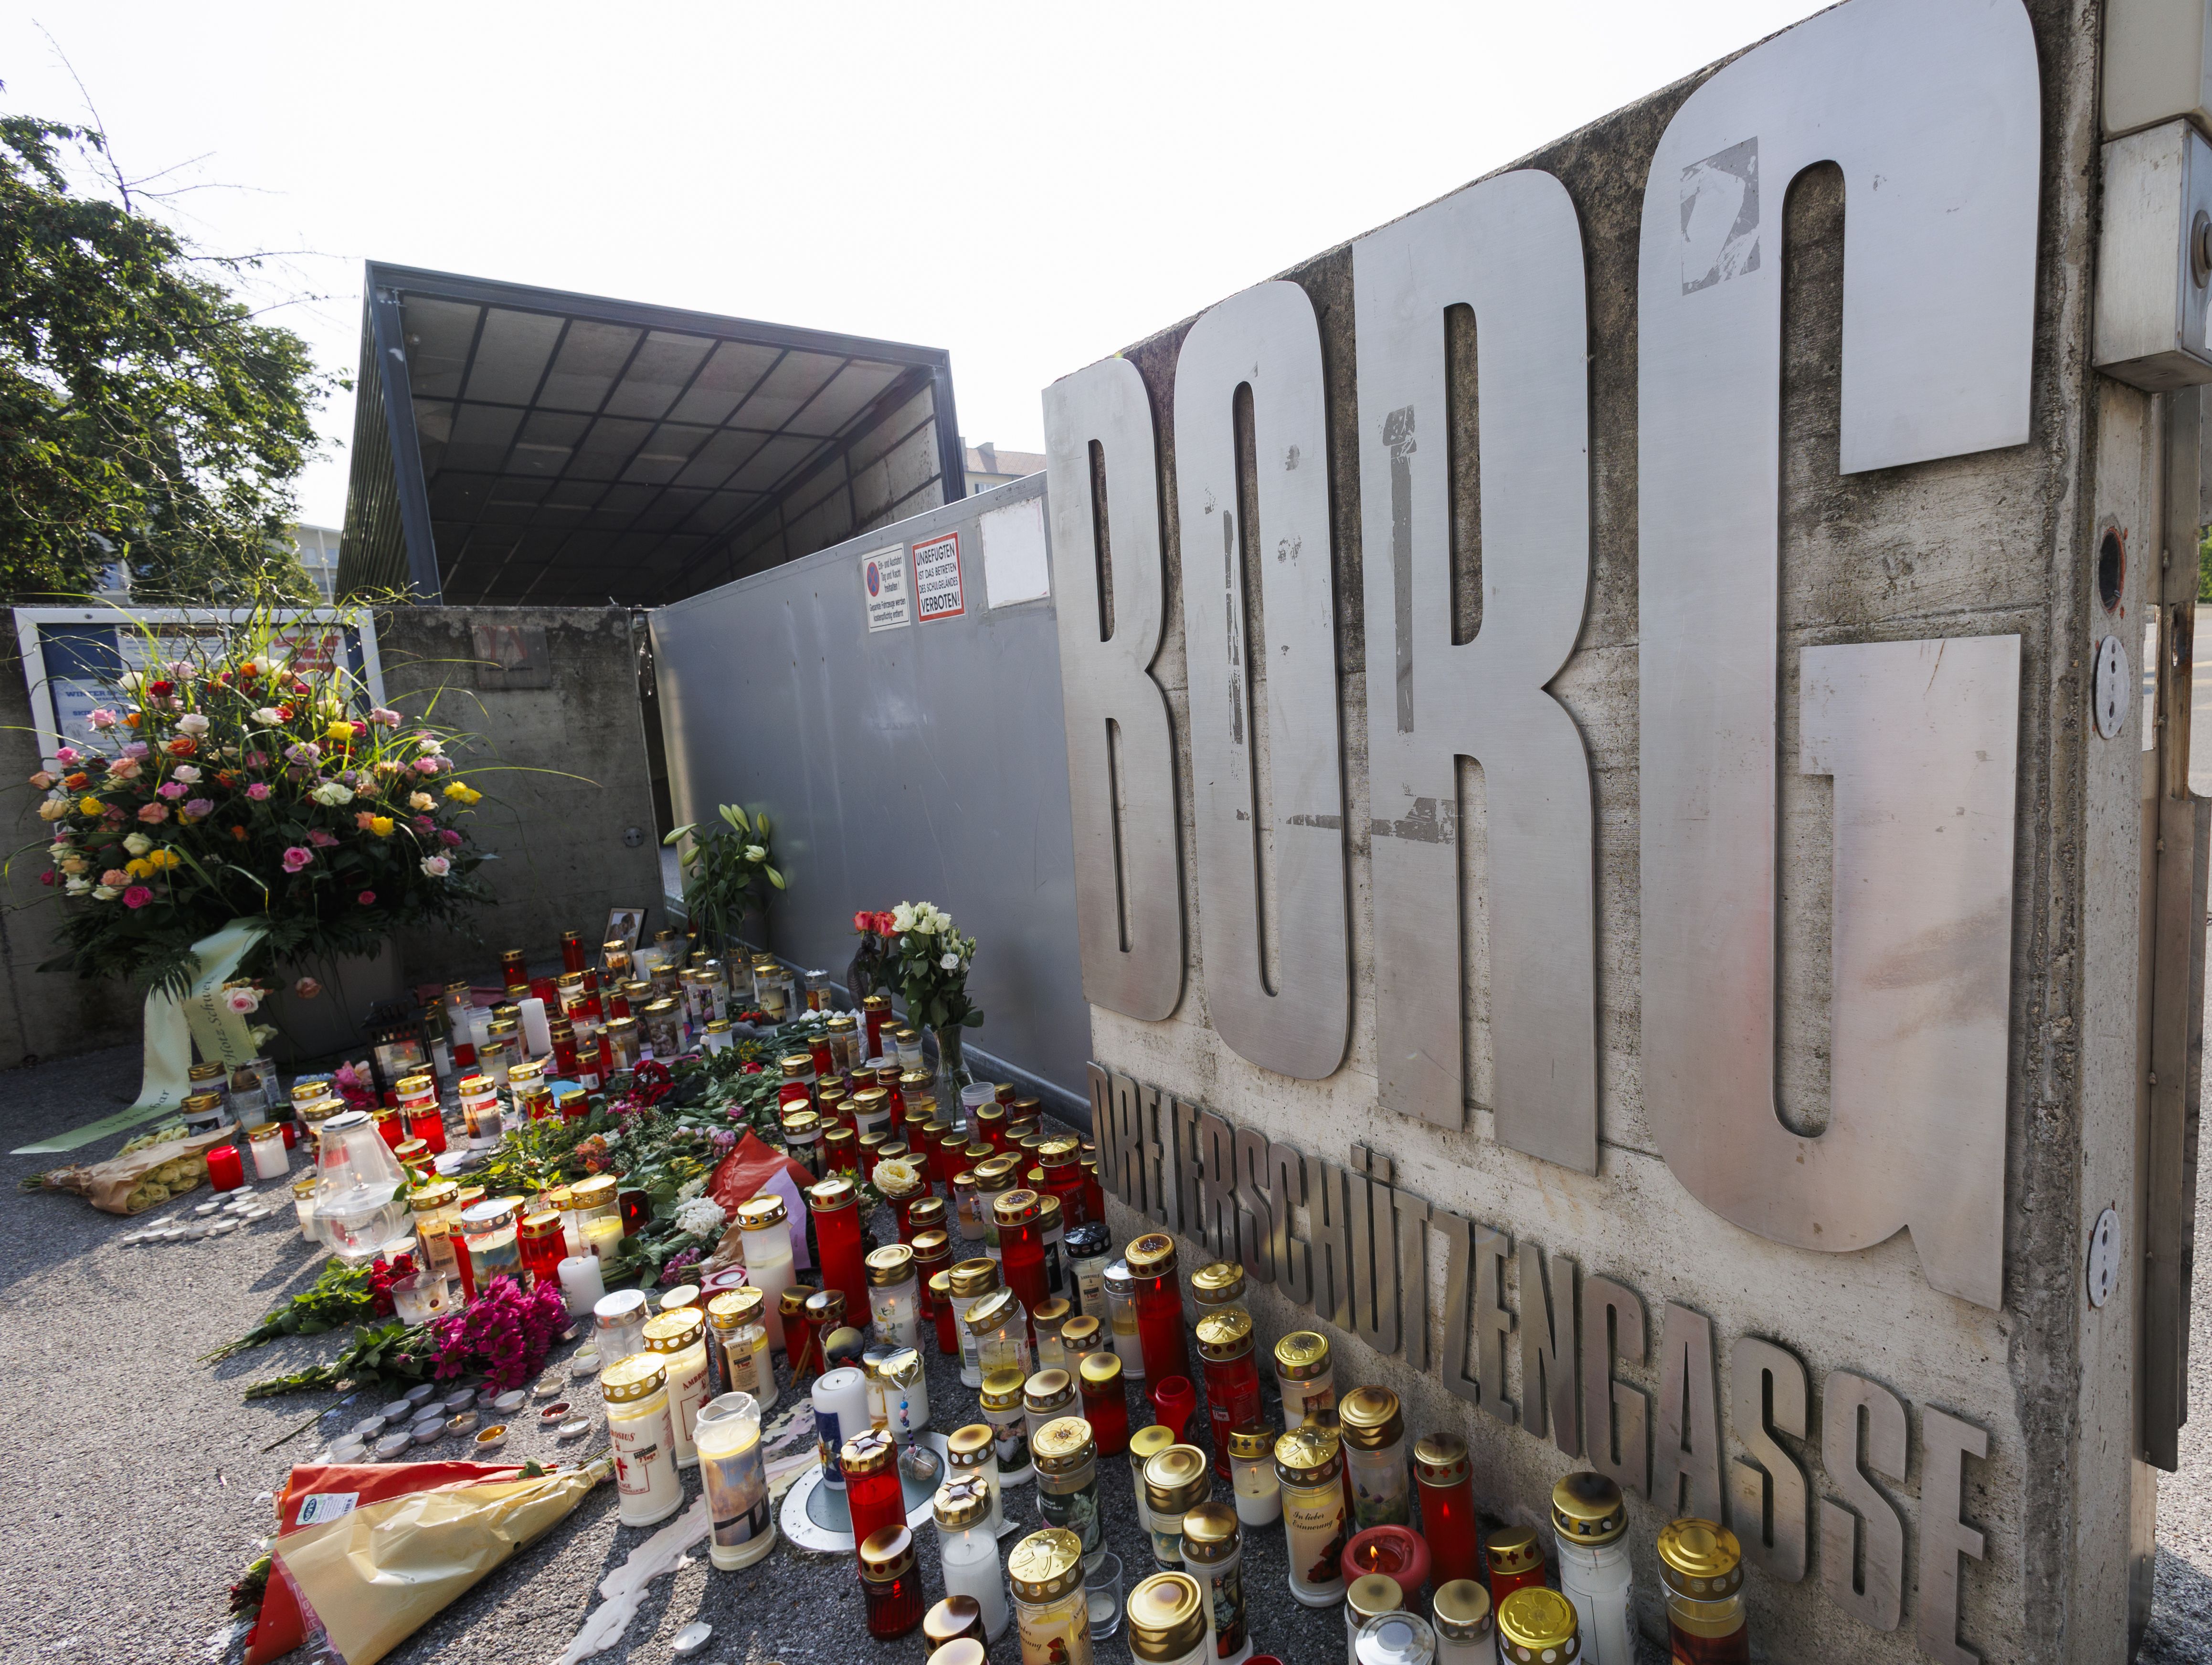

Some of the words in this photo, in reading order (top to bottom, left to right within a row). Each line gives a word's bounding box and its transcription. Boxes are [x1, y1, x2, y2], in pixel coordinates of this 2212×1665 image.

[890, 555, 902, 567] Ausfahrt
[916, 542, 955, 566] UNBEFUGTEN
[892, 569, 901, 579] Nacht
[925, 567, 934, 579] DAS
[935, 562, 957, 576] BETRETEN
[885, 582, 898, 593] freihalten
[926, 576, 958, 592] SCHULGELÄNDES
[869, 602, 881, 613] Geparkte
[881, 600, 895, 610] Fahrzeuge
[895, 598, 906, 606] werden
[921, 591, 960, 613] VERBOTEN!
[873, 611, 892, 622] kostenpflichtig
[893, 609, 904, 619] entfernt
[1043, 0, 2043, 1311] BORG
[1087, 1061, 1988, 1665] DREIERSCHÜTZENGASSE
[644, 1453, 656, 1462] Tage
[1293, 1511, 1303, 1520] In
[1305, 1512, 1324, 1520] lieber
[1292, 1519, 1333, 1530] Erinnerung
